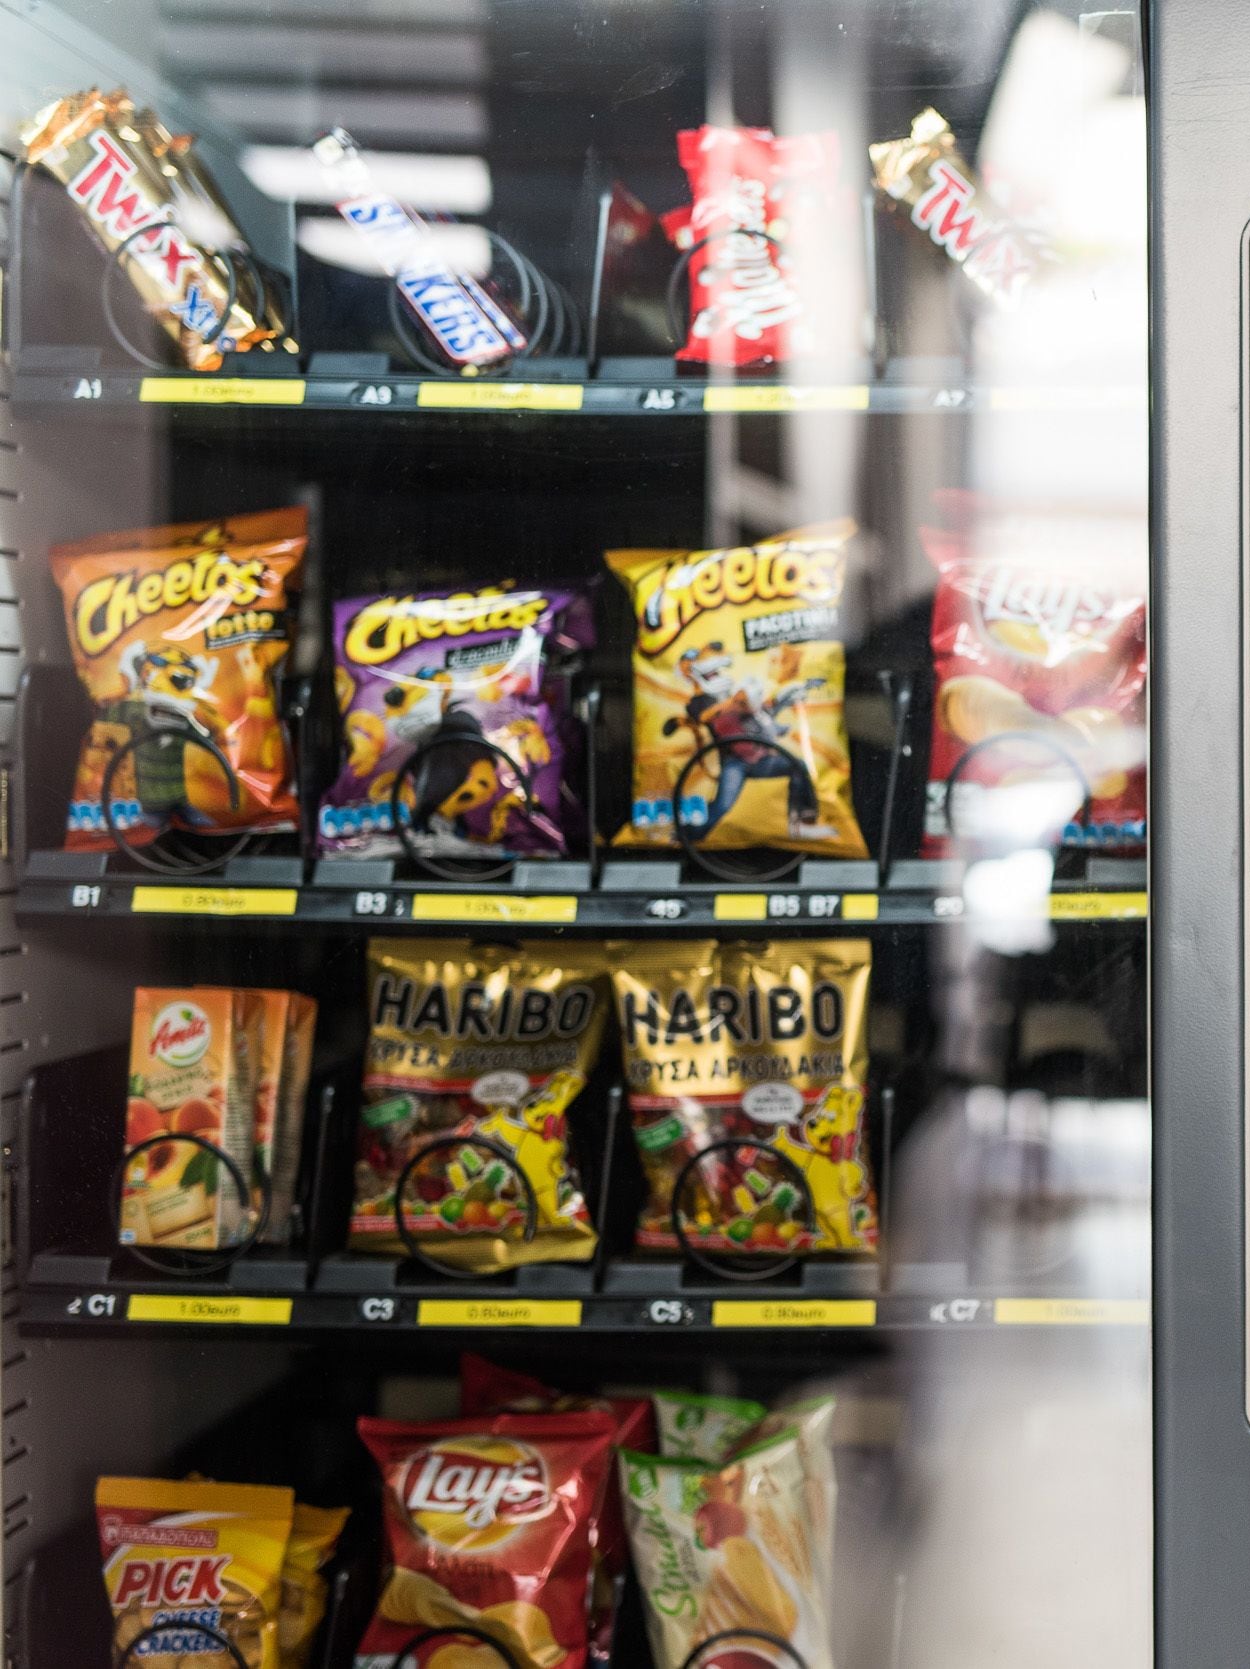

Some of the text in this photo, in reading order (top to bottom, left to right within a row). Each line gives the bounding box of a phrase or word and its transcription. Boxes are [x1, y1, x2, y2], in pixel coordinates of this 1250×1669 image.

[73, 378, 101, 399] A1
[75, 550, 266, 657] Cheetos
[72, 885, 100, 908] B1
[356, 892, 387, 914] B3
[769, 895, 840, 917] B5 B7
[373, 974, 596, 1040] HARIBO
[624, 982, 843, 1046] HARIBO
[87, 1293, 116, 1317] C1
[363, 1298, 394, 1321] C3
[651, 1300, 682, 1323] C5
[112, 1553, 233, 1608] PICK
